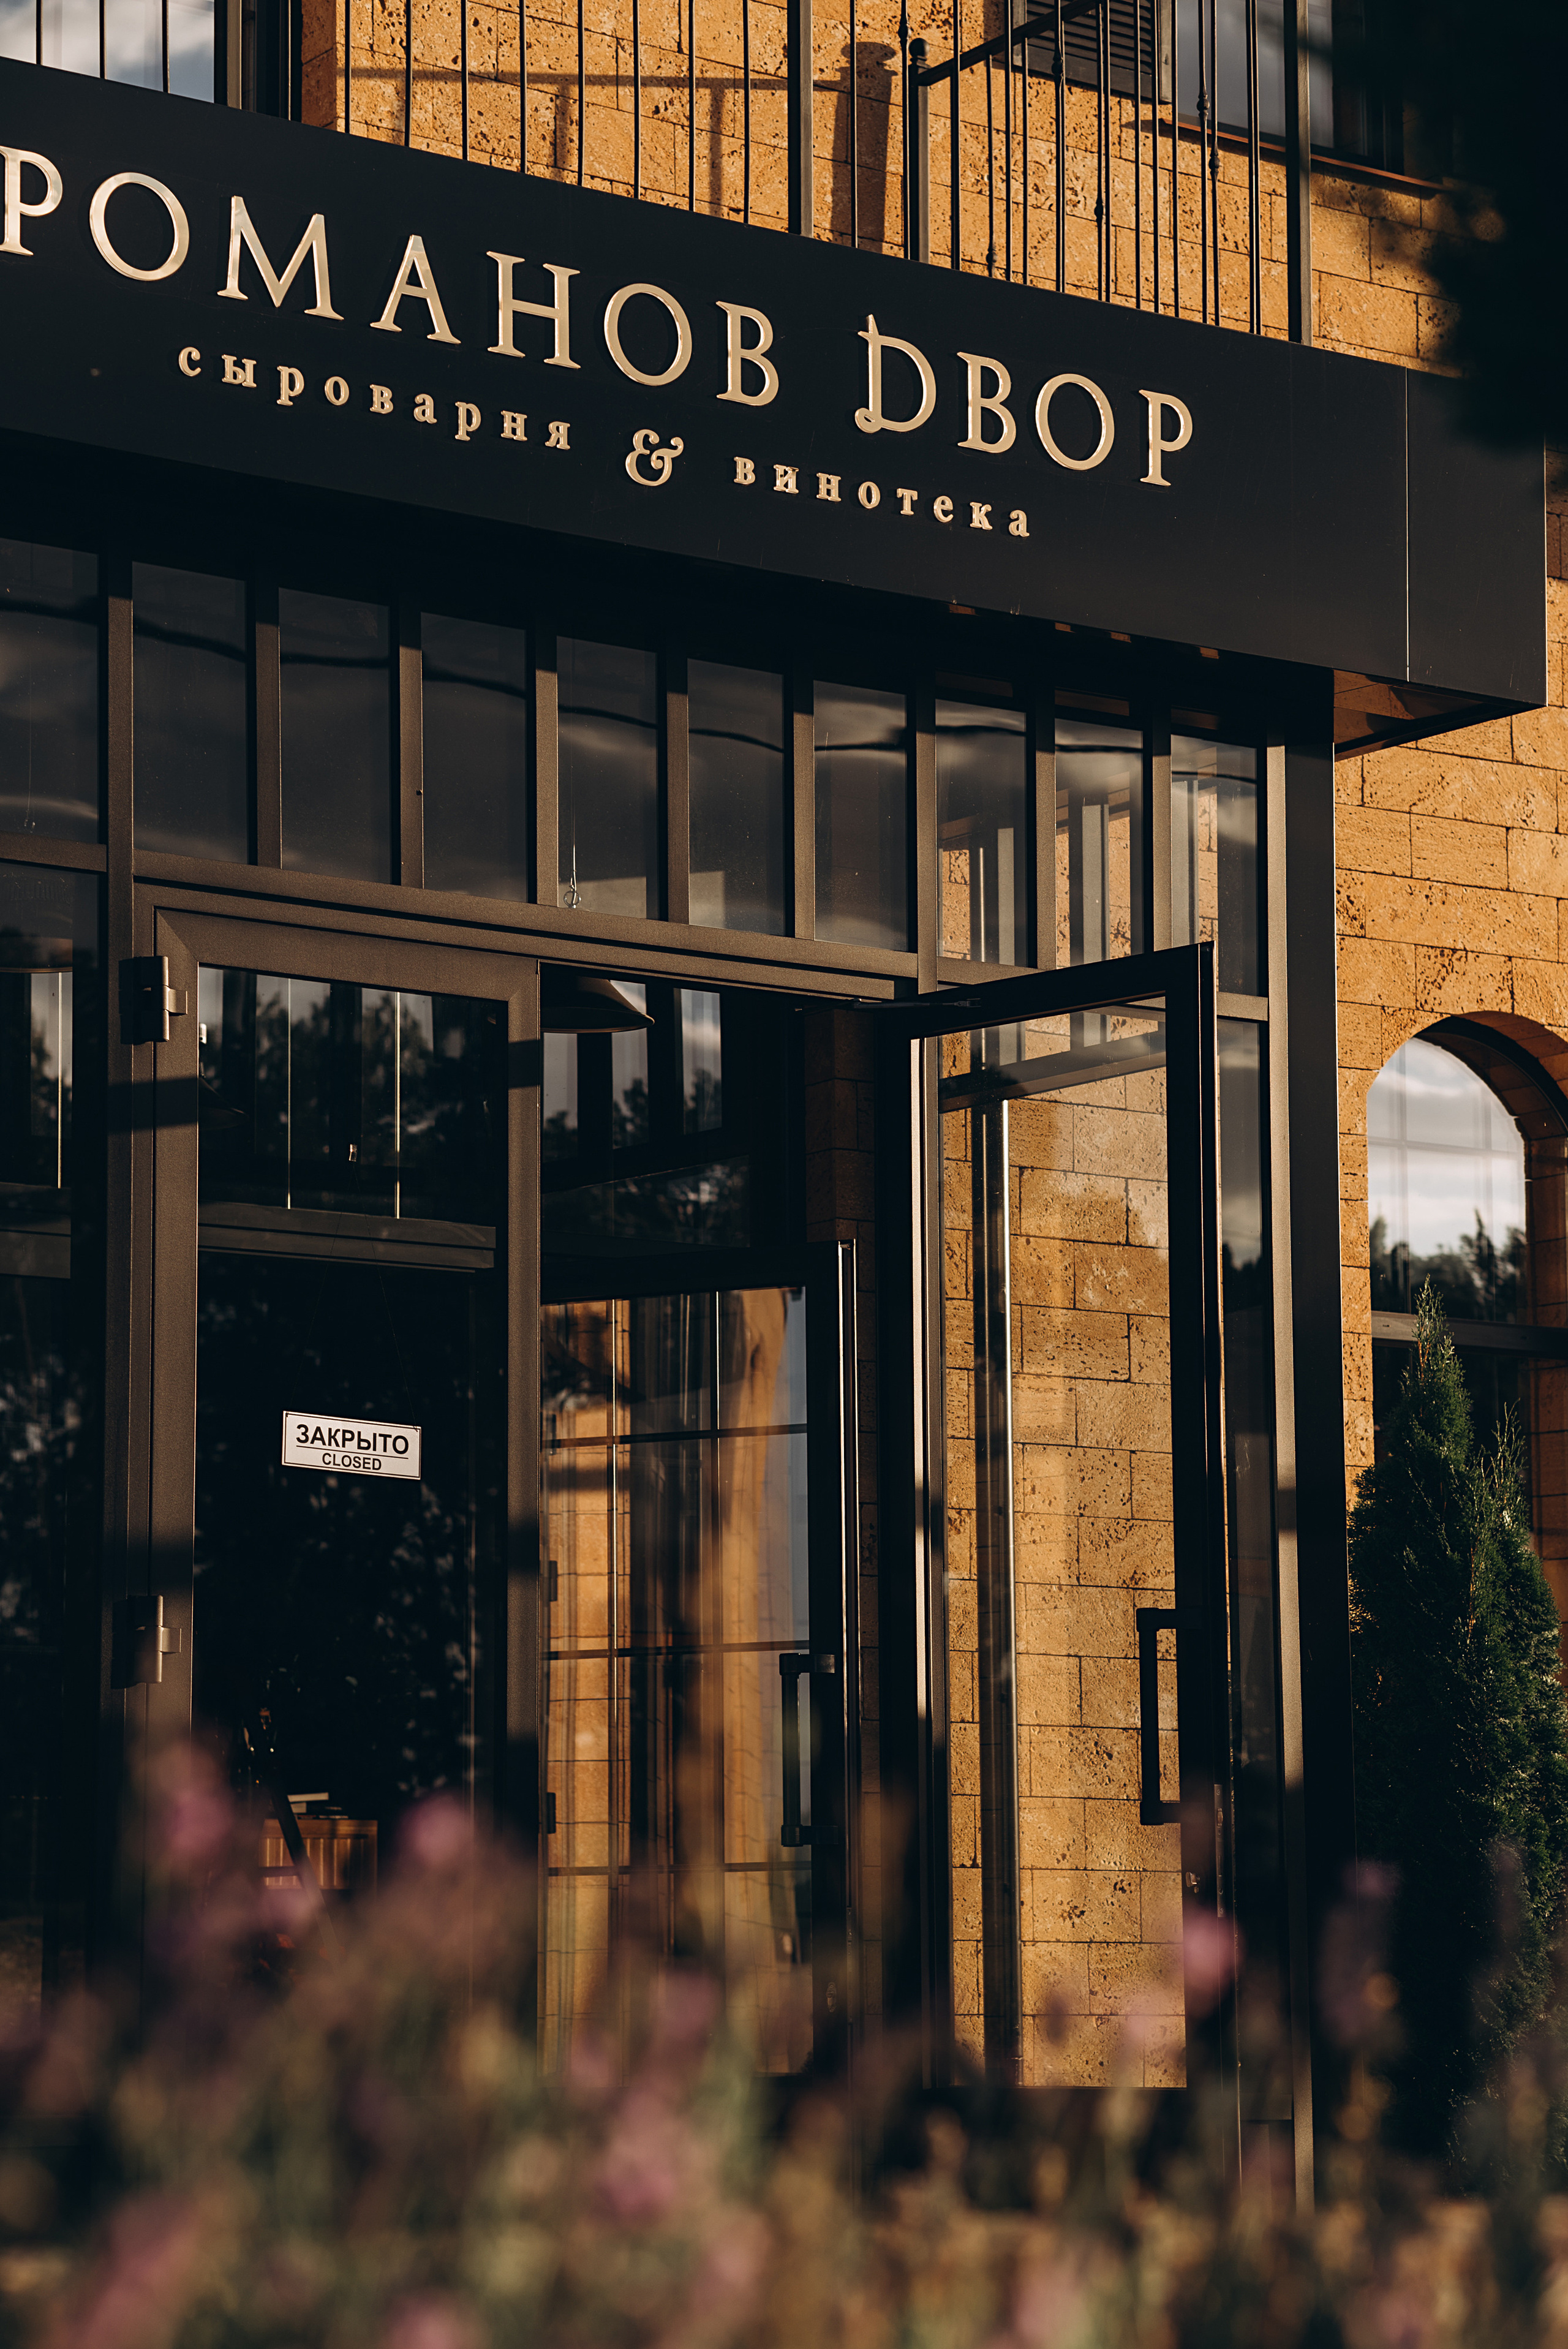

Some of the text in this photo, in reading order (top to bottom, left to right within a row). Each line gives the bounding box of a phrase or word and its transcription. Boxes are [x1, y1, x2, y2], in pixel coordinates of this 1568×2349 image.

[0, 145, 780, 407] РОМАНОВ
[177, 345, 1031, 538] сыроварня & винотека
[296, 1423, 409, 1455] ЗАКРЫТО
[322, 1452, 382, 1471] CLOSED
